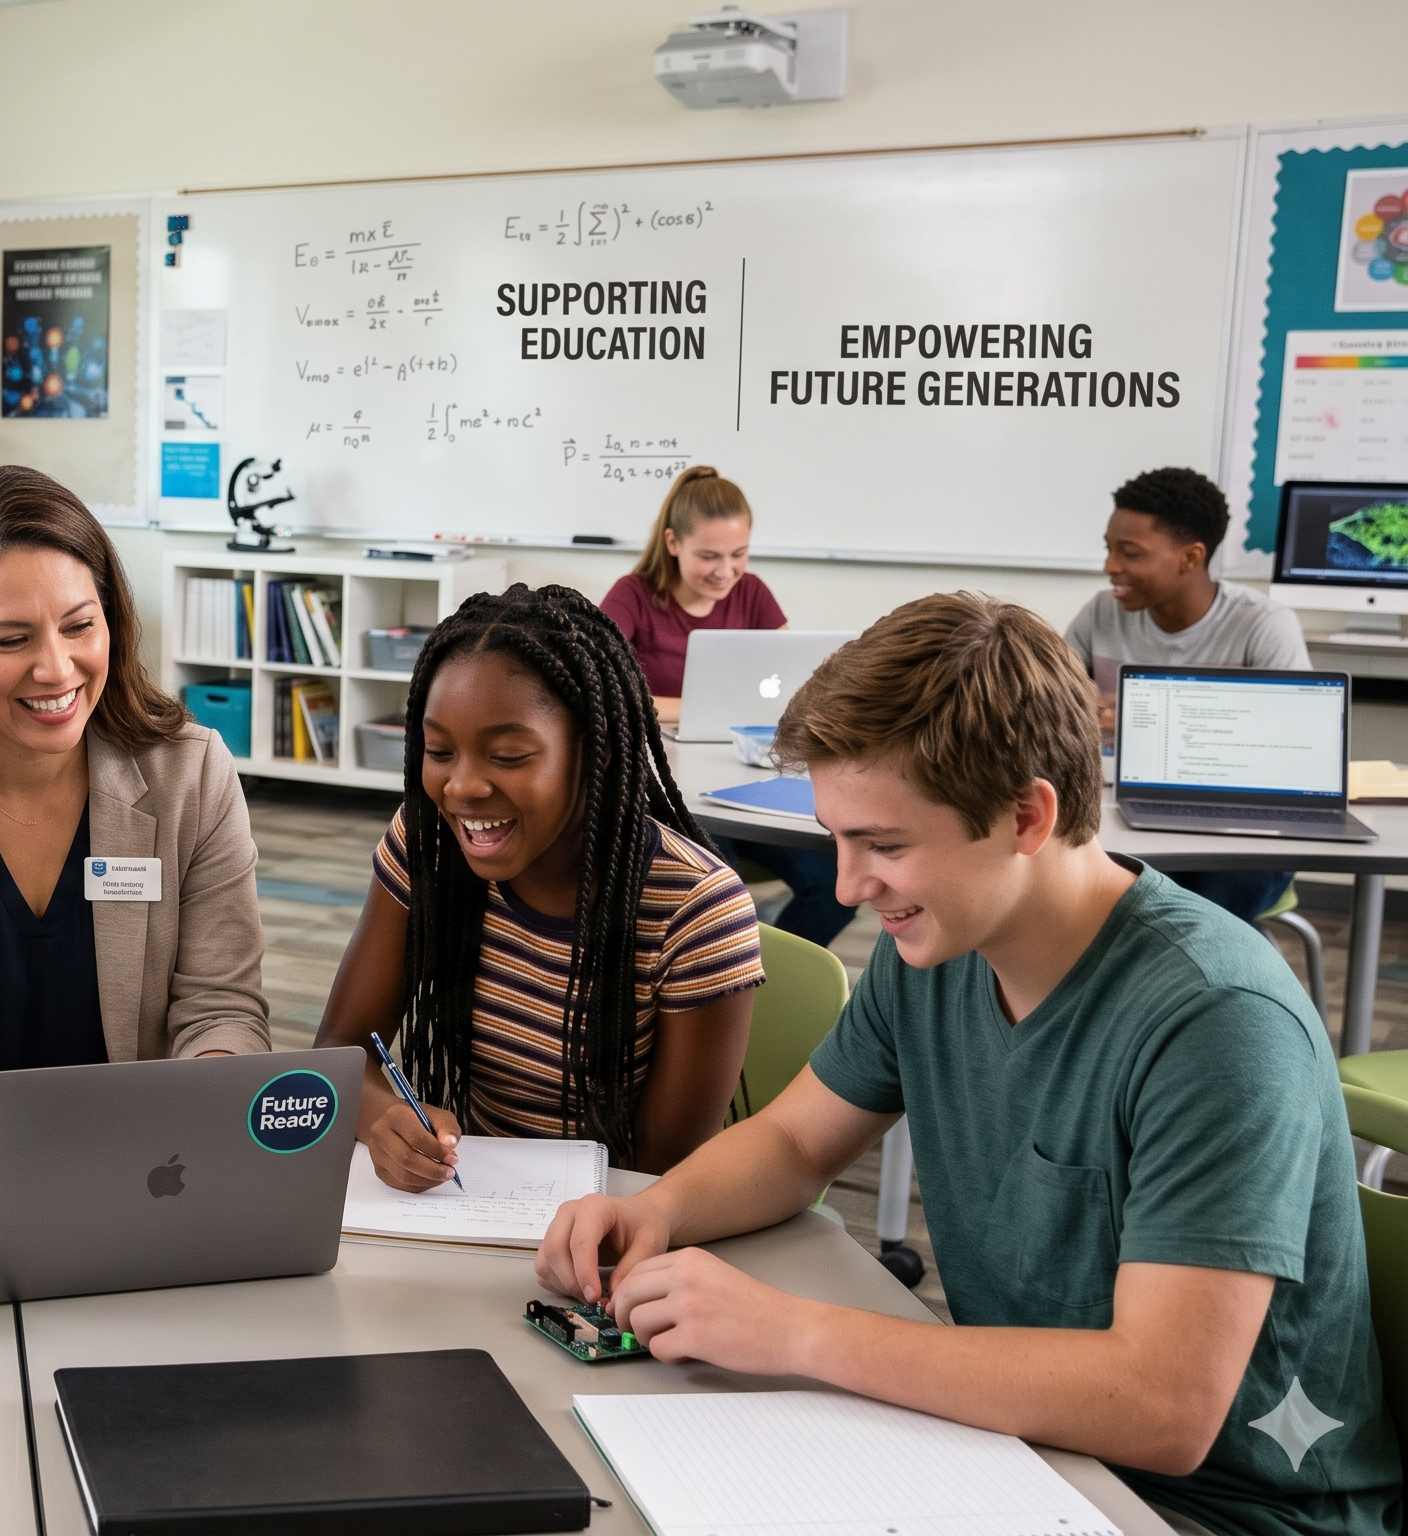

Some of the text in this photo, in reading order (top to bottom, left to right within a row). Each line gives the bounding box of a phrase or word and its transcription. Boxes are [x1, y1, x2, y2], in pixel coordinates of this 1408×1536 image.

[496, 279, 707, 317] SUPPORTING
[521, 326, 705, 361] EDUCATION
[840, 323, 1092, 359] EMPOWERING
[770, 370, 1180, 408] FUTURE GENERATIONS
[260, 1111, 325, 1130] Ready
[261, 1096, 328, 1113] Future
